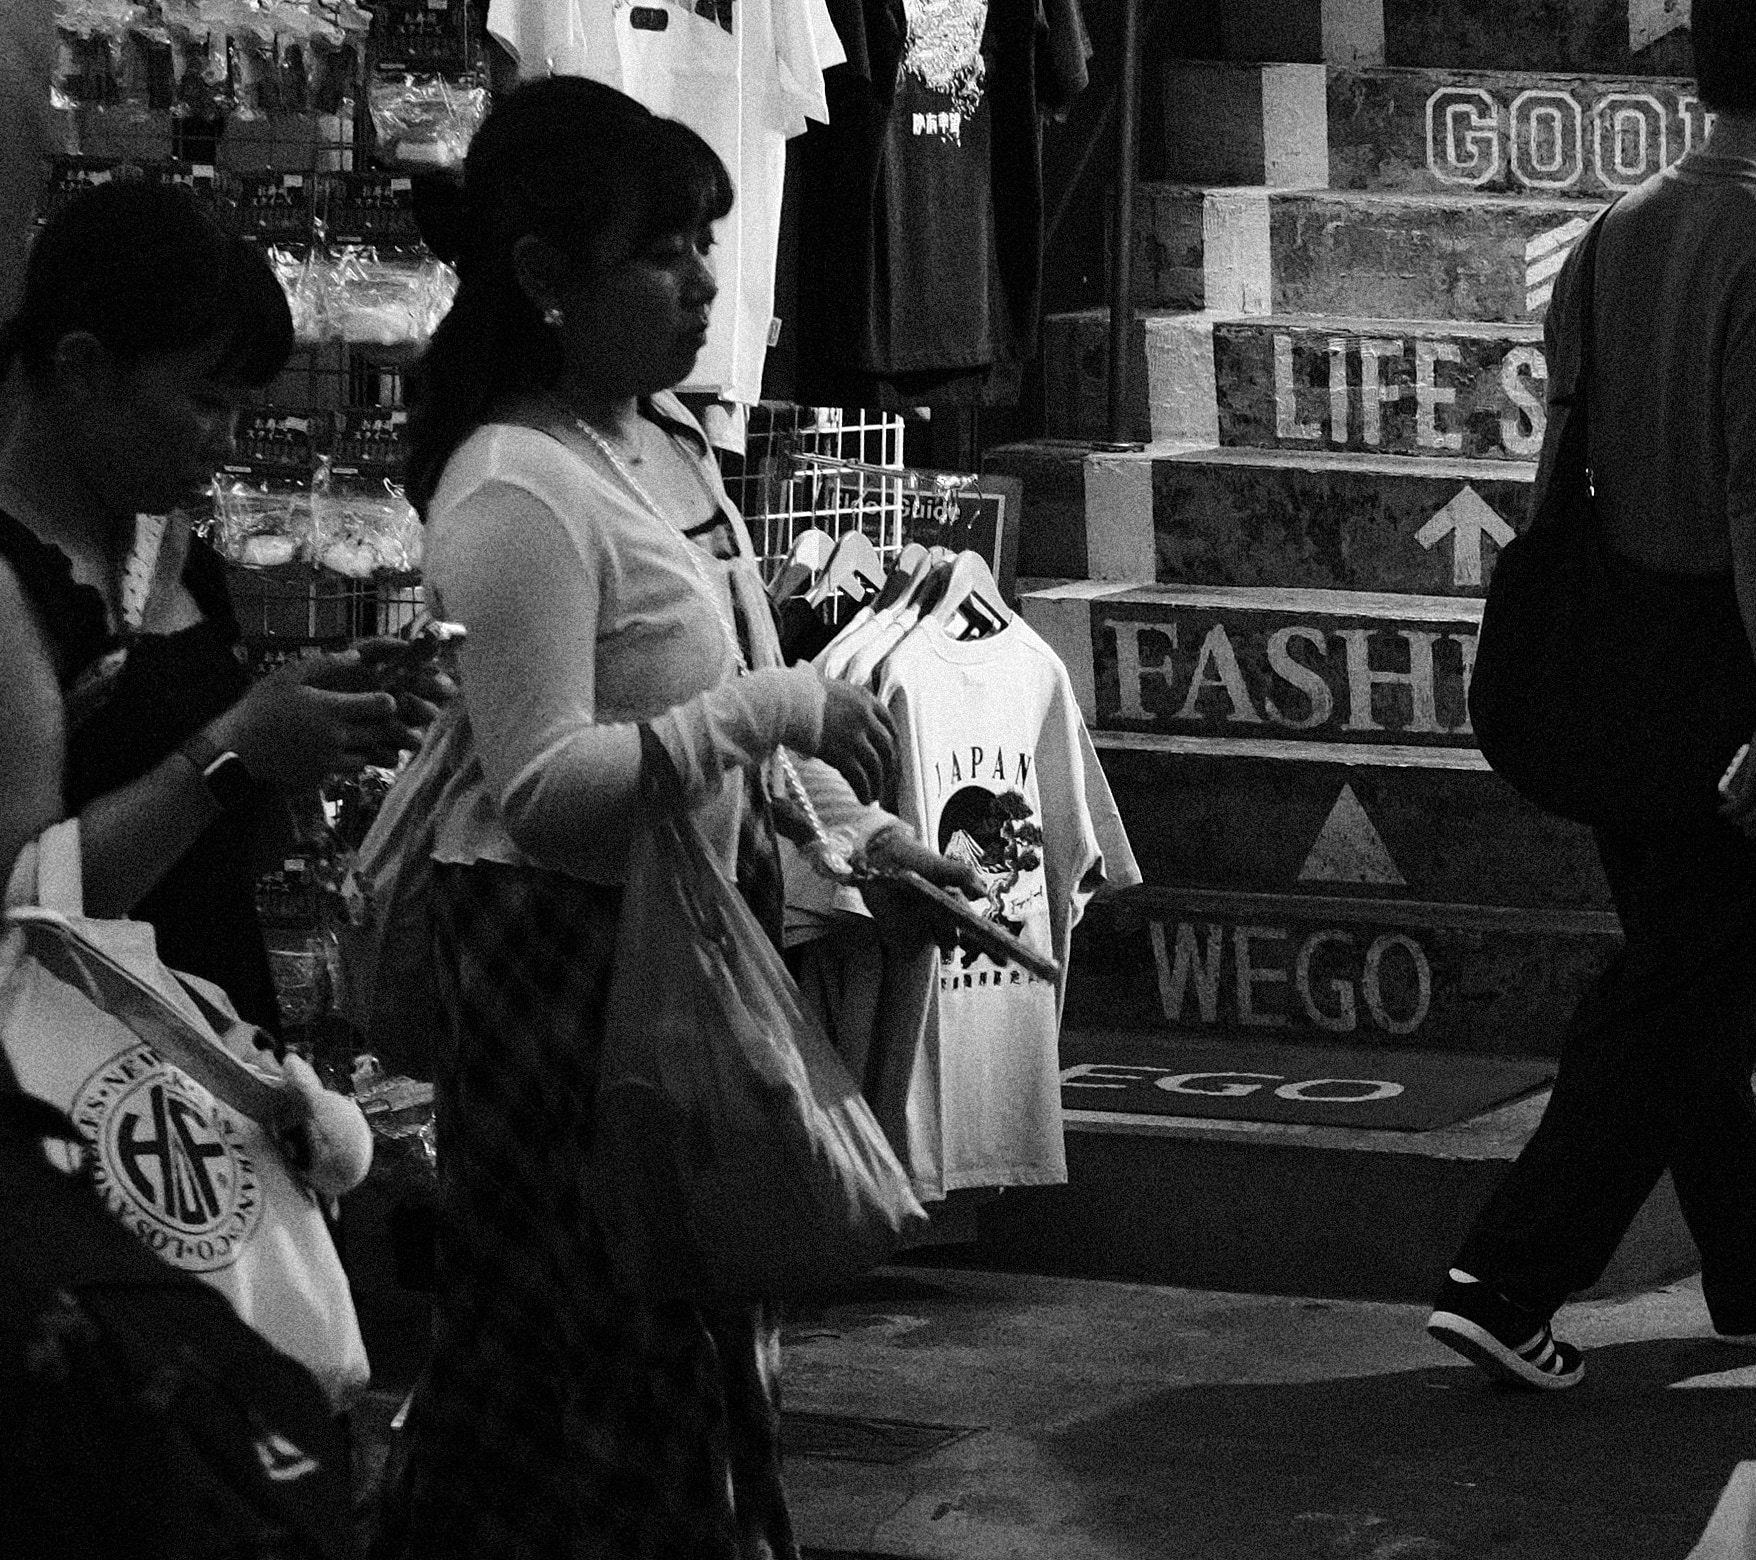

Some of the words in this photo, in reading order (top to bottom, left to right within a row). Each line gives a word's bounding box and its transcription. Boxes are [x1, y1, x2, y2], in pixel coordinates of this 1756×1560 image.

[934, 744, 1032, 798] JAPAN
[1150, 920, 1433, 1034] WEGO
[1060, 1062, 1406, 1103] EGO
